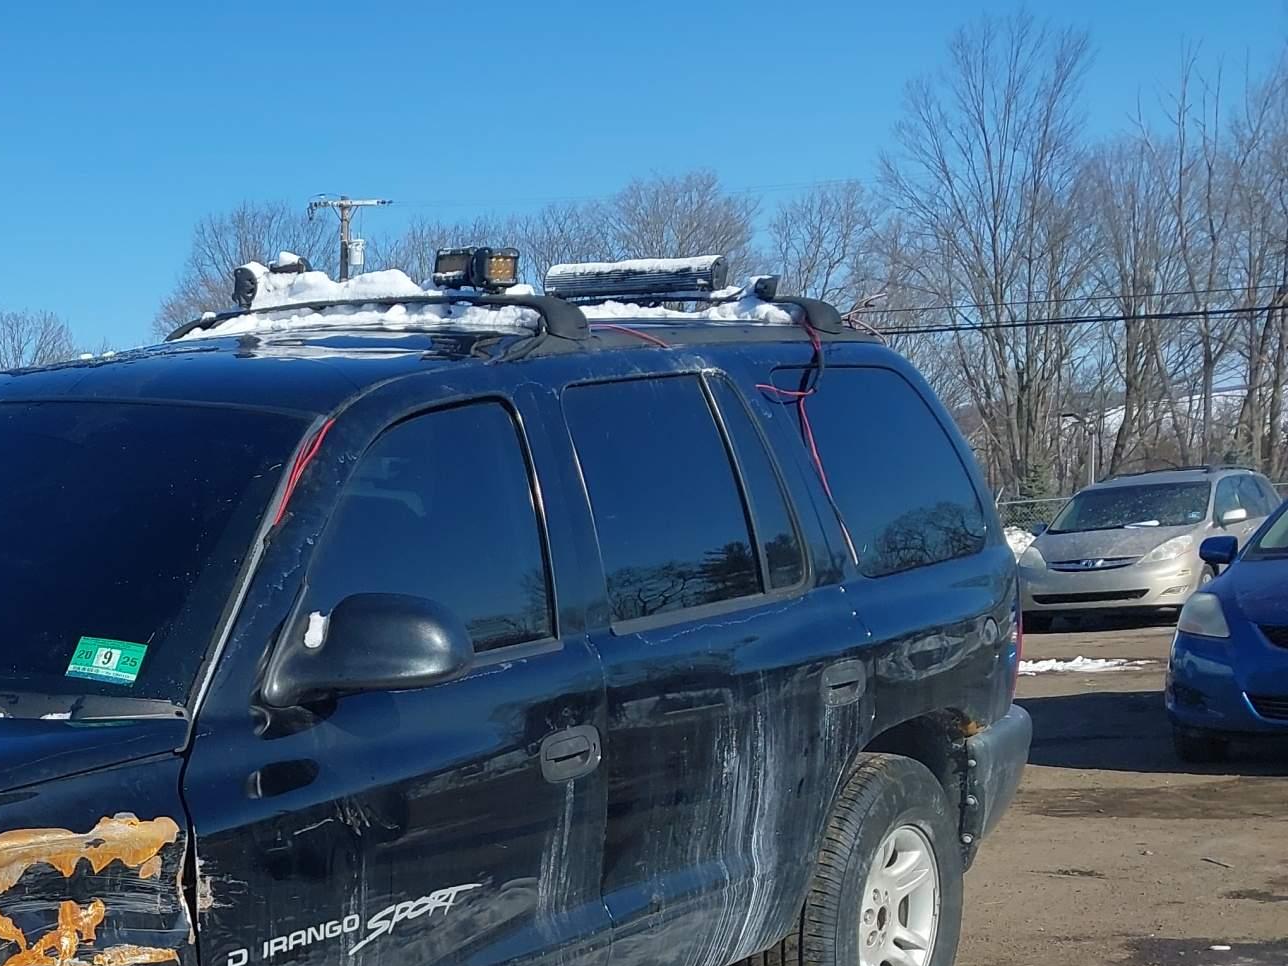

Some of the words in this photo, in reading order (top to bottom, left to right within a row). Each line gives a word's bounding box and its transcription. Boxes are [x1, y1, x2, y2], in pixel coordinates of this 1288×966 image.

[101, 650, 113, 665] 9
[119, 655, 139, 667] 25
[349, 883, 482, 955] SPORT
